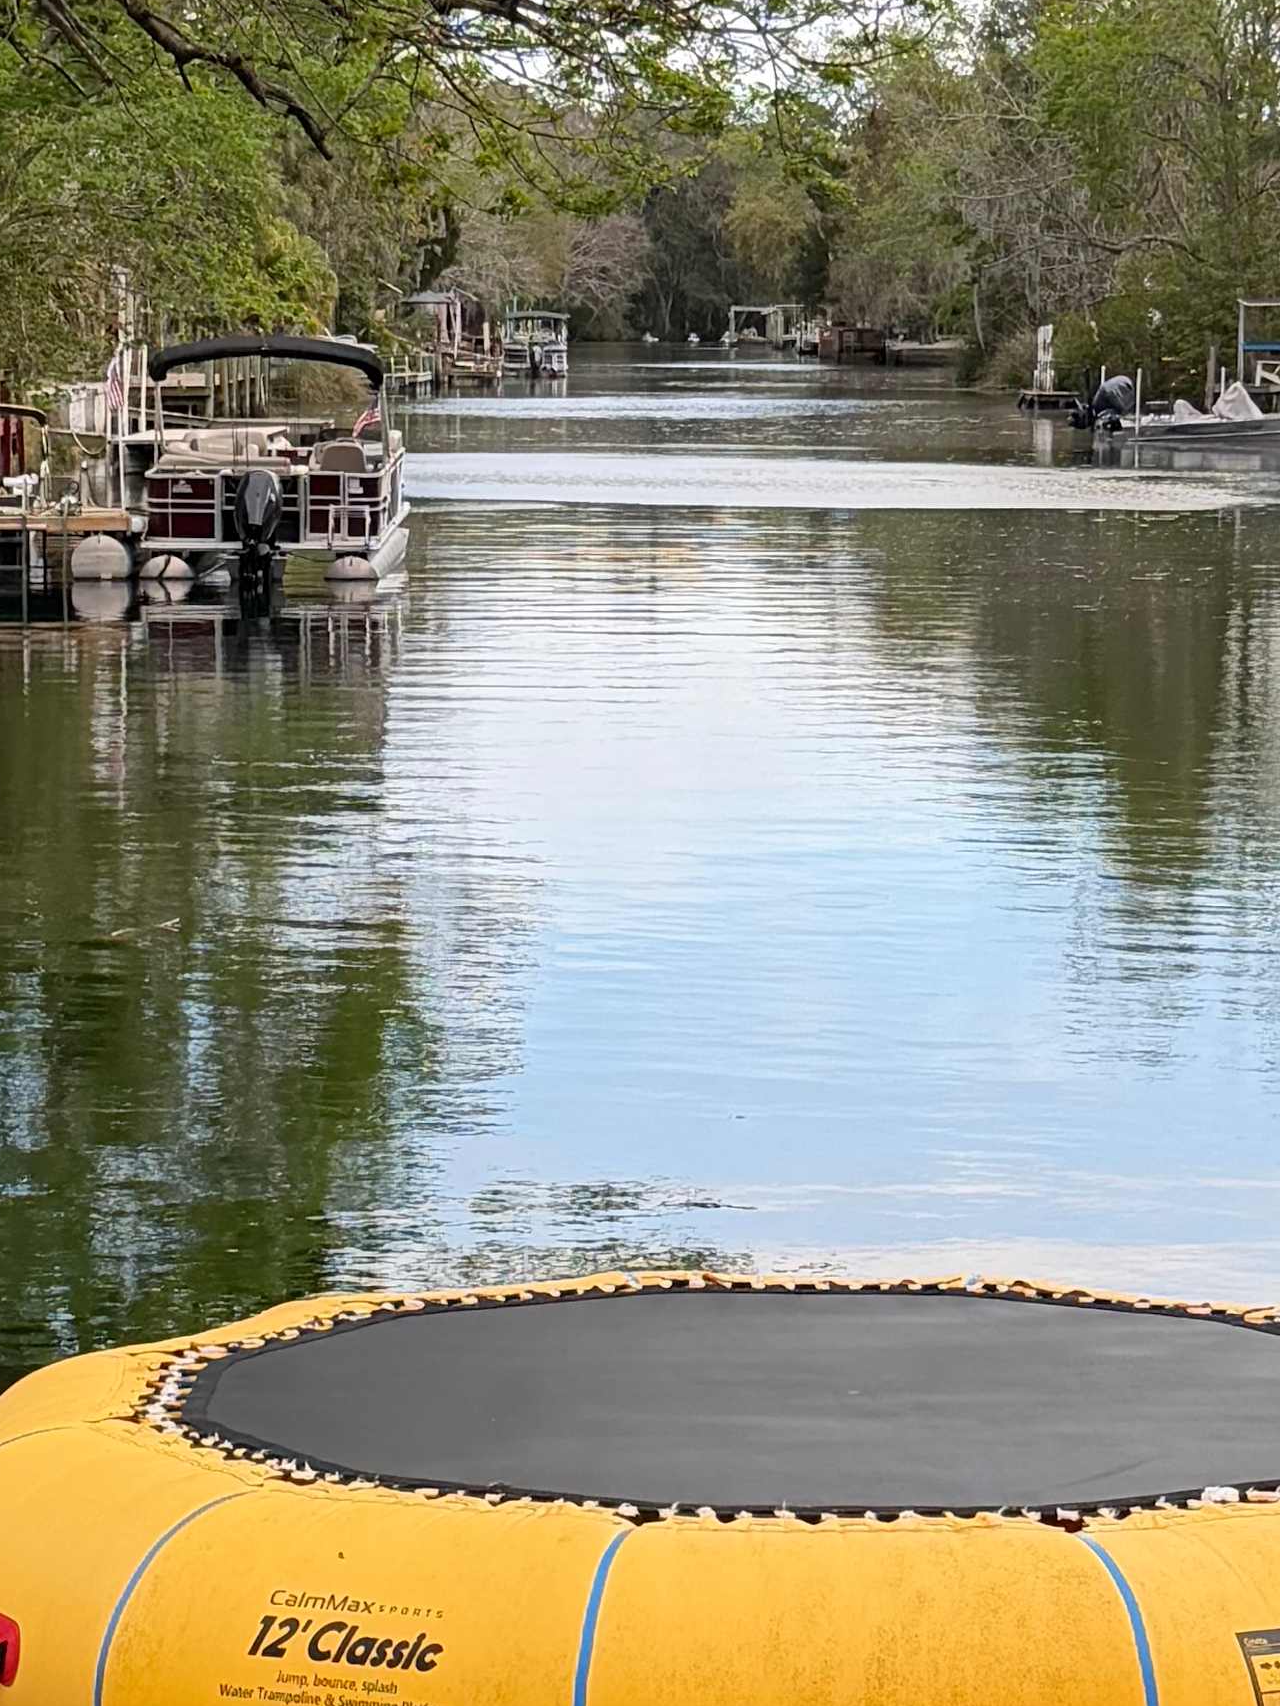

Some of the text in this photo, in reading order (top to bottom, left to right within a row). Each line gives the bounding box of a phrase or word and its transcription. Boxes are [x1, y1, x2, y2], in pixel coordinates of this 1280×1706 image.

[270, 1589, 376, 1614] CalmMax
[248, 1615, 444, 1672] 12' Classic
[219, 1684, 254, 1699] Water
[257, 1686, 321, 1706] Trampoline
[276, 1670, 398, 1695] Jump, bounce, splash
